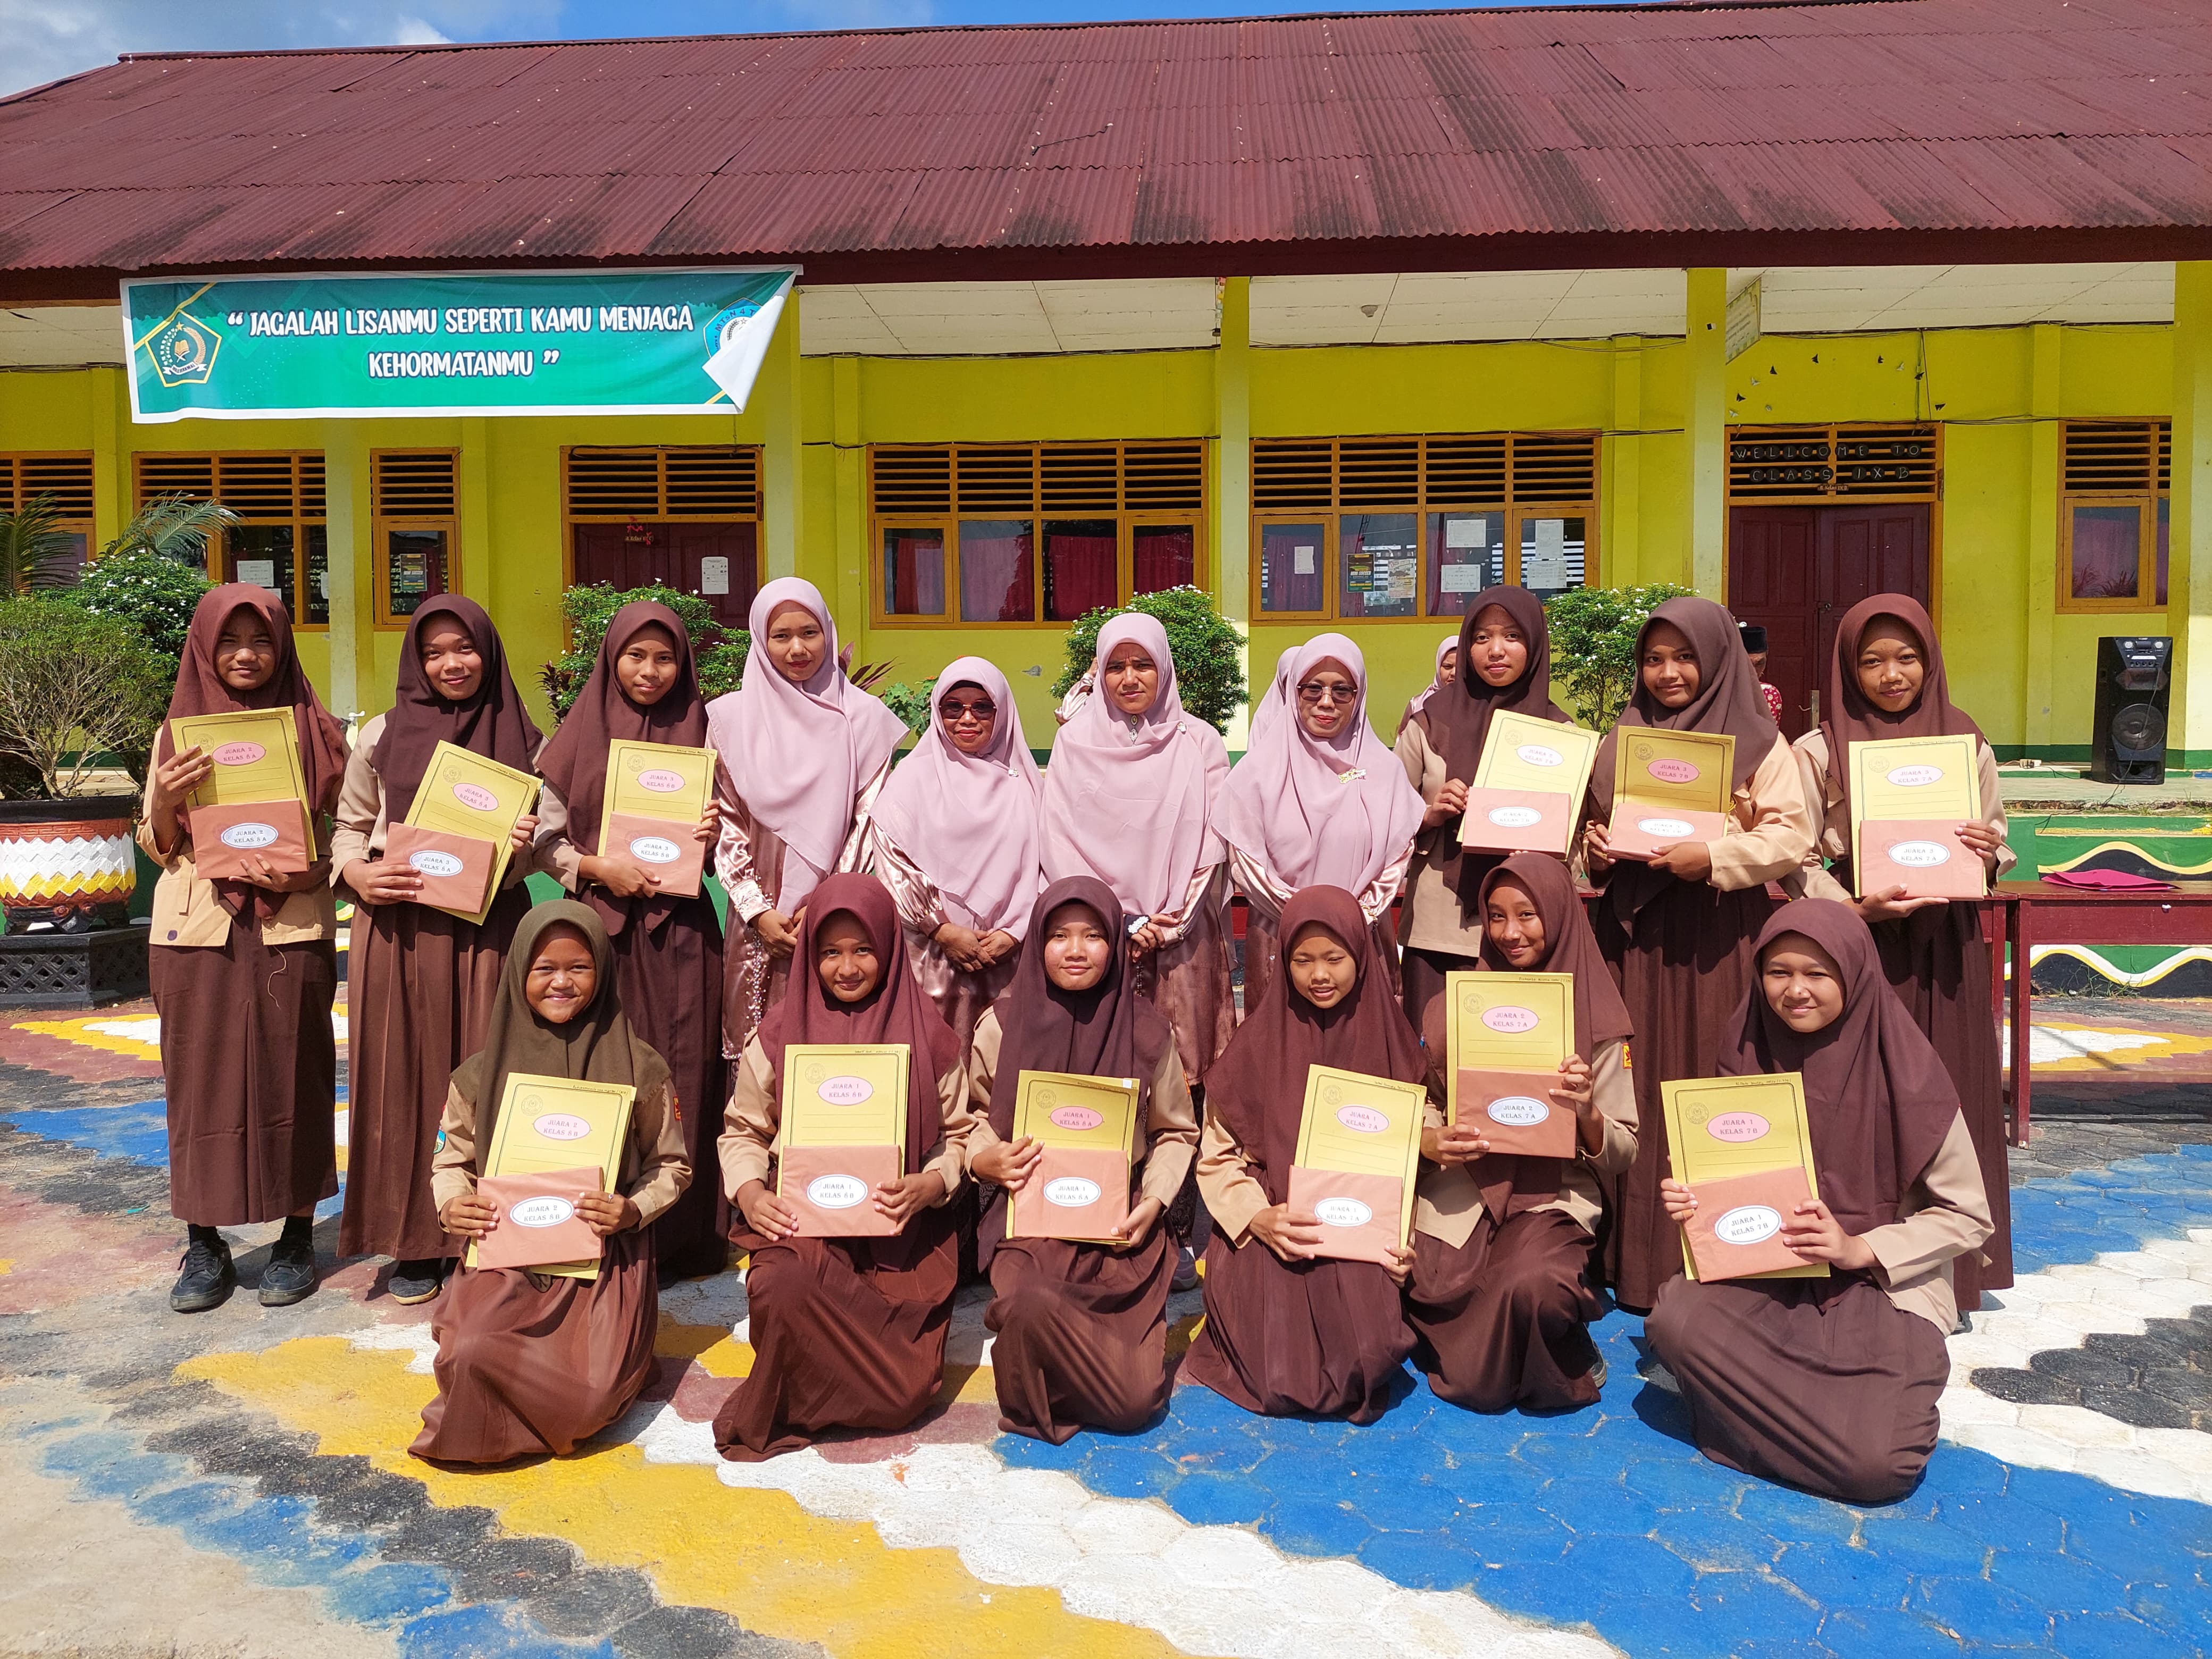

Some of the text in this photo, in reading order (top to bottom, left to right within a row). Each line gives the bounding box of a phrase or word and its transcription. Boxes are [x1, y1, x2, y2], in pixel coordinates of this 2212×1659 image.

[250, 311, 338, 336] JAGALAH
[346, 308, 437, 334] LISANMU
[445, 307, 524, 333] SEPERTI
[531, 306, 592, 332] KAMU
[599, 305, 693, 331] MENJAGA
[368, 351, 533, 378] KEHORMATANMU
[1736, 446, 1919, 458] WELLCOME TO
[1753, 467, 1908, 480] CLASS IX B
[459, 793, 477, 805] KELAS
[464, 787, 483, 799] JUARA
[1350, 1111, 1369, 1120] JUARA
[1346, 1119, 1366, 1128] KELAS
[1731, 1217, 1755, 1226] JUARA
[1731, 1226, 1755, 1236] KELAS
